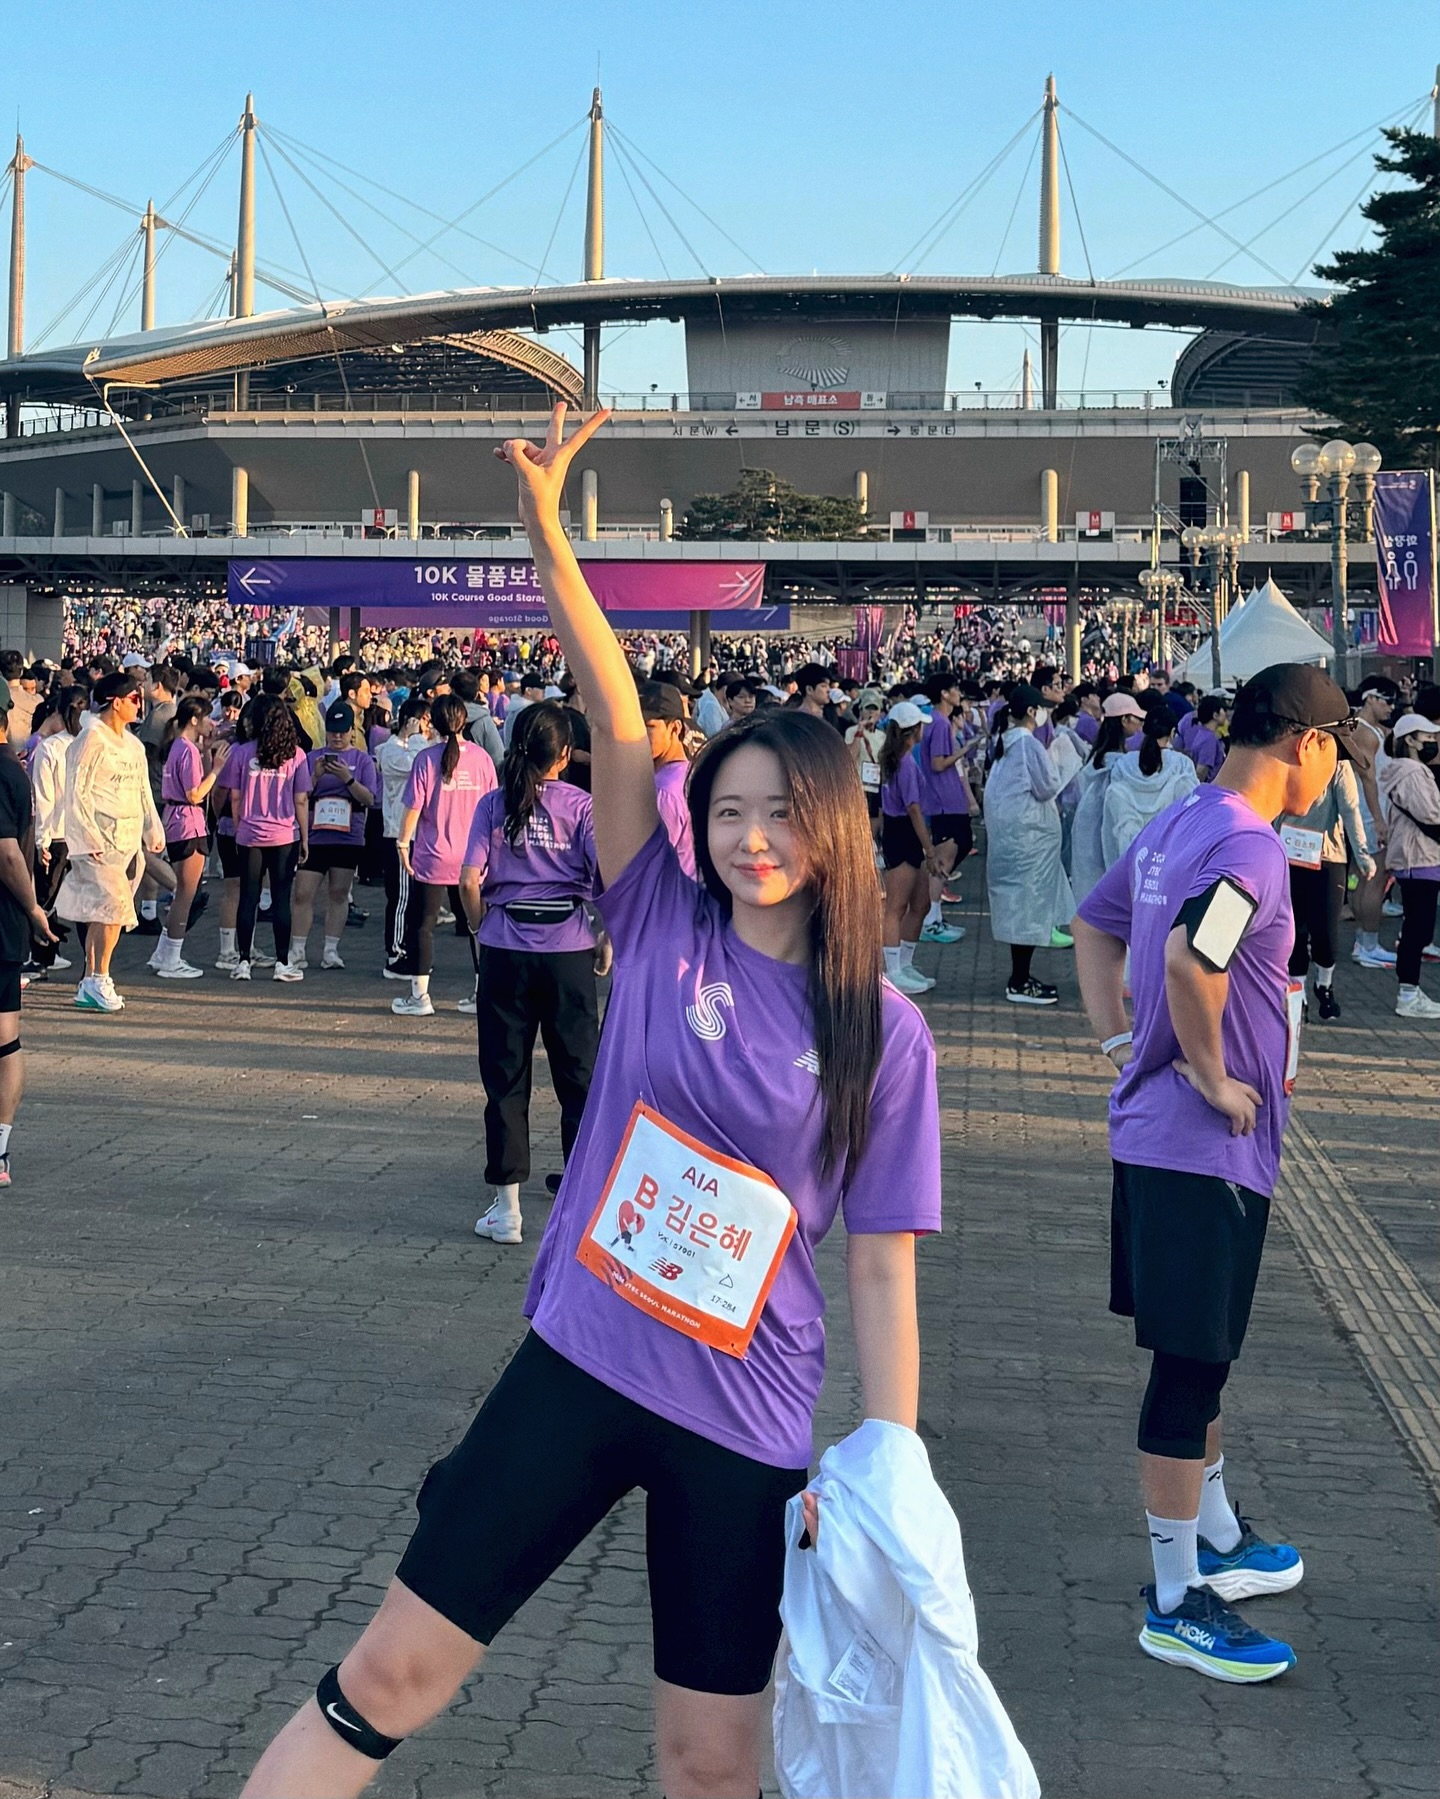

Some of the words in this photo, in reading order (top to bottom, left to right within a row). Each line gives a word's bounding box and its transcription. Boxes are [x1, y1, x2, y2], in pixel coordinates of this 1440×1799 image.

[414, 565, 458, 585] 10K
[431, 592, 449, 602] 10K
[451, 592, 485, 603] Course
[487, 592, 513, 602] Good
[681, 1166, 720, 1198] AIA
[633, 1173, 660, 1211] B
[665, 1194, 753, 1262] 김은혜
[661, 1304, 702, 1330] MARATHON
[1174, 1619, 1217, 1651] HOKA
